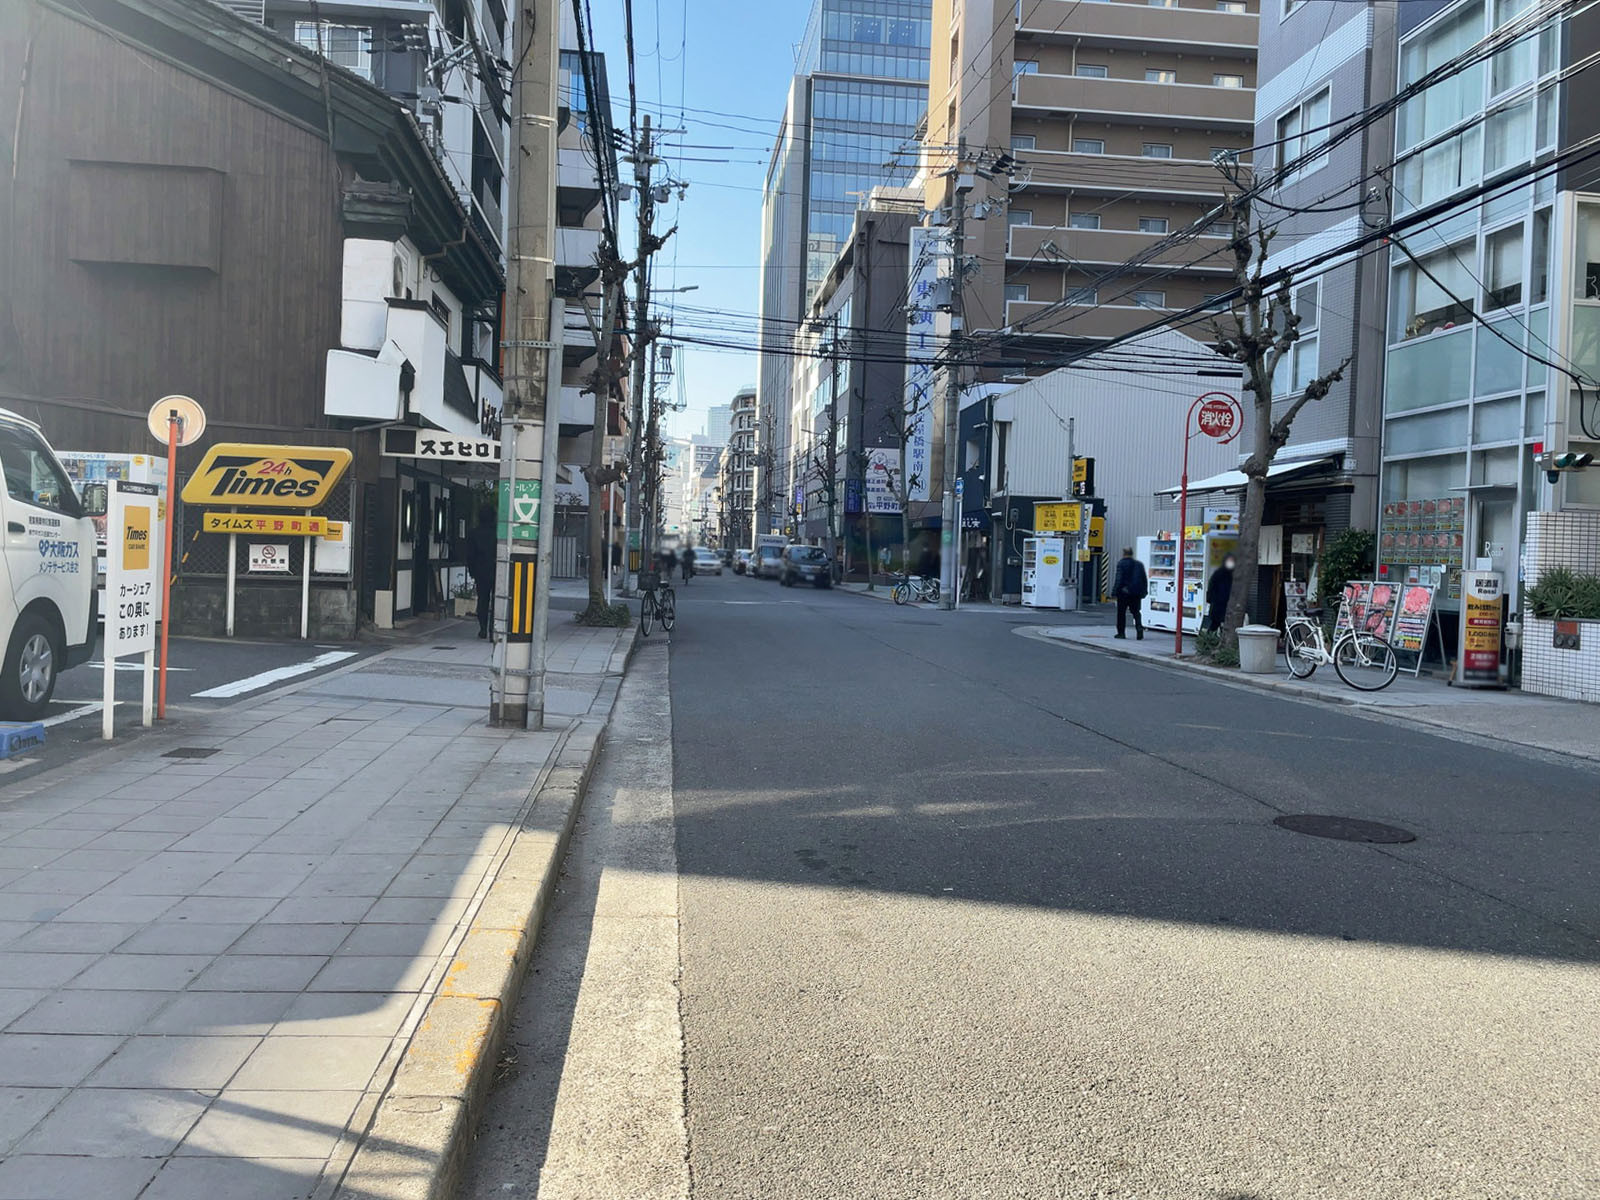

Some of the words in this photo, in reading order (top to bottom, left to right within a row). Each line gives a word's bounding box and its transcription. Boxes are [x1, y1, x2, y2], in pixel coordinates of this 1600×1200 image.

[1201, 410, 1232, 427] 消火栓
[420, 439, 490, 458] スエヒロ
[210, 468, 320, 497] Times
[126, 525, 147, 541] Times
[120, 582, 151, 597] カーシェア
[1475, 579, 1498, 588] 居酒屋
[119, 601, 150, 619] この奥に
